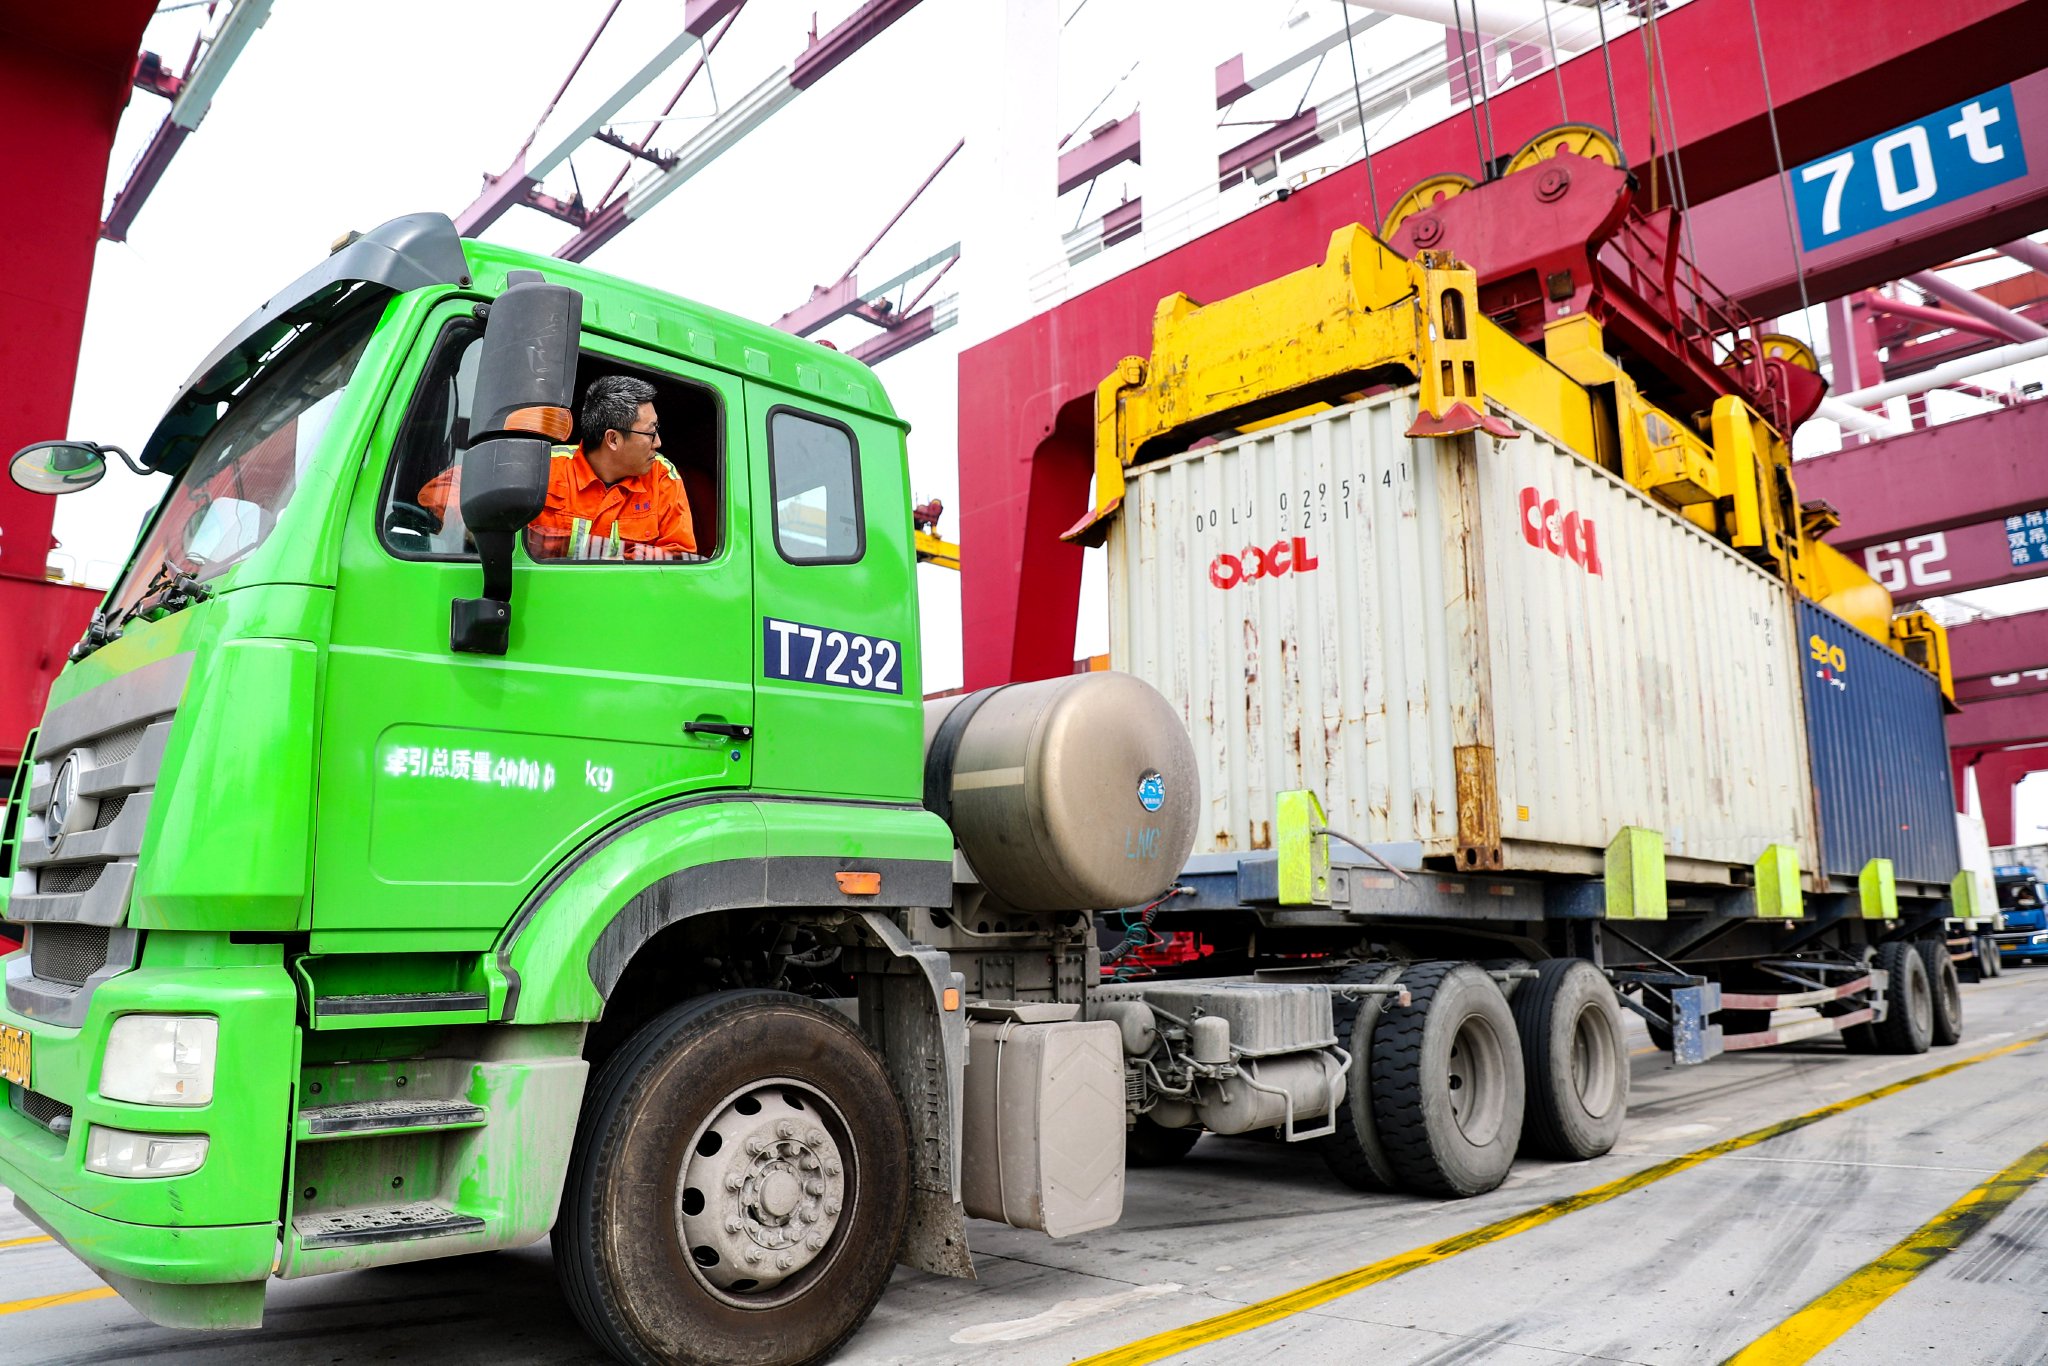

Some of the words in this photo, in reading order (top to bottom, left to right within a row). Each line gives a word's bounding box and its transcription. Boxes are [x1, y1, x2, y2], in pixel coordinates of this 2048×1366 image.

[1209, 537, 1319, 590] OOCL
[1864, 531, 1952, 593] 62
[769, 619, 898, 691] T7232
[586, 760, 613, 792] kg
